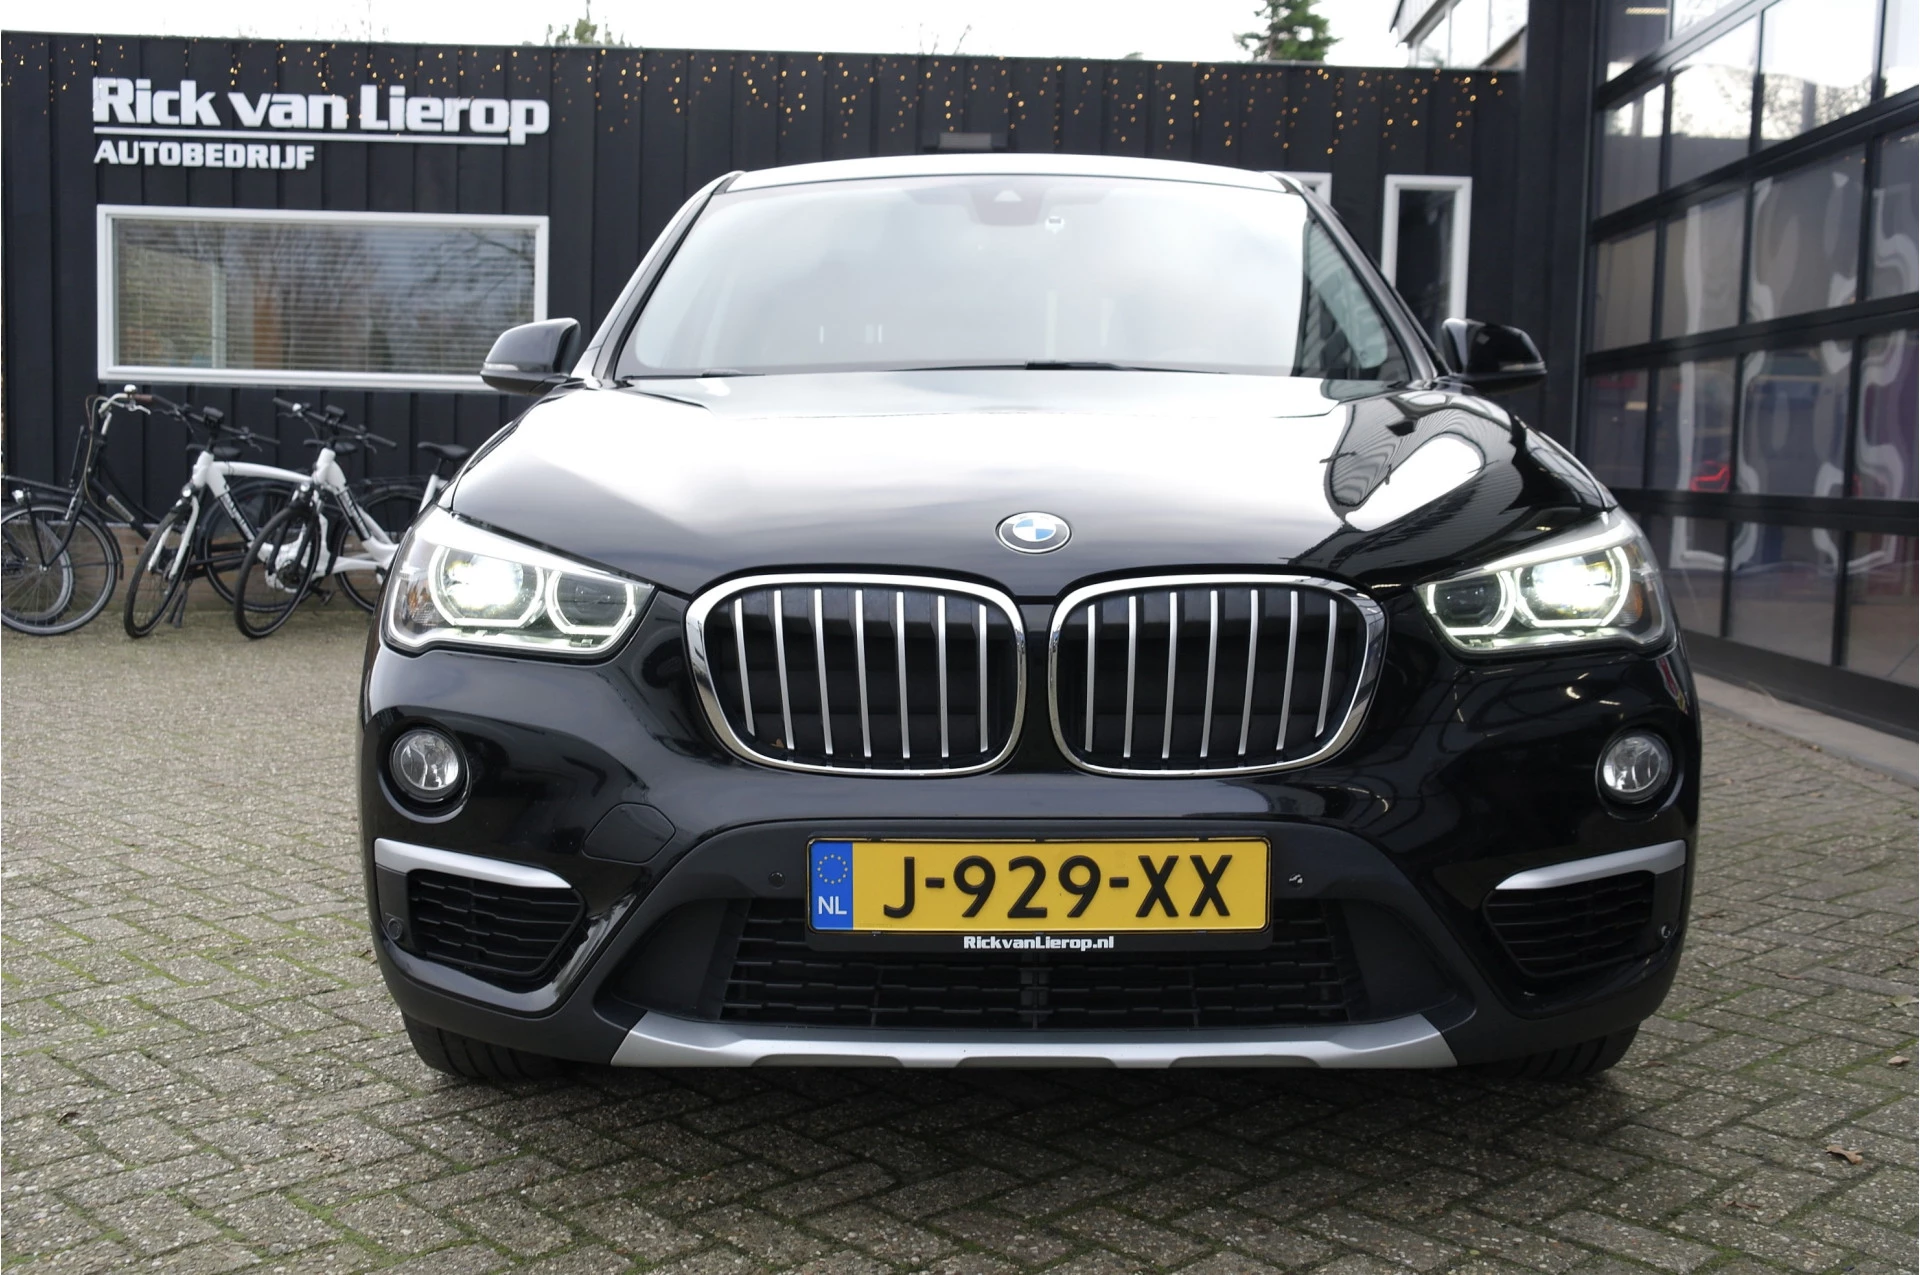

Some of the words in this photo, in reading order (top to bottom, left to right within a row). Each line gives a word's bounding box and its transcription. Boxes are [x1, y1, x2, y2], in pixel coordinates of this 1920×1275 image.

[92, 77, 221, 126] Rick
[227, 91, 349, 130] van
[359, 84, 550, 146] Lierop
[93, 140, 316, 170] AUTOBEDRIJF
[882, 854, 1233, 919] J-929-XX
[818, 895, 847, 915] NL
[963, 935, 1114, 951] RickvanLierop.nl
